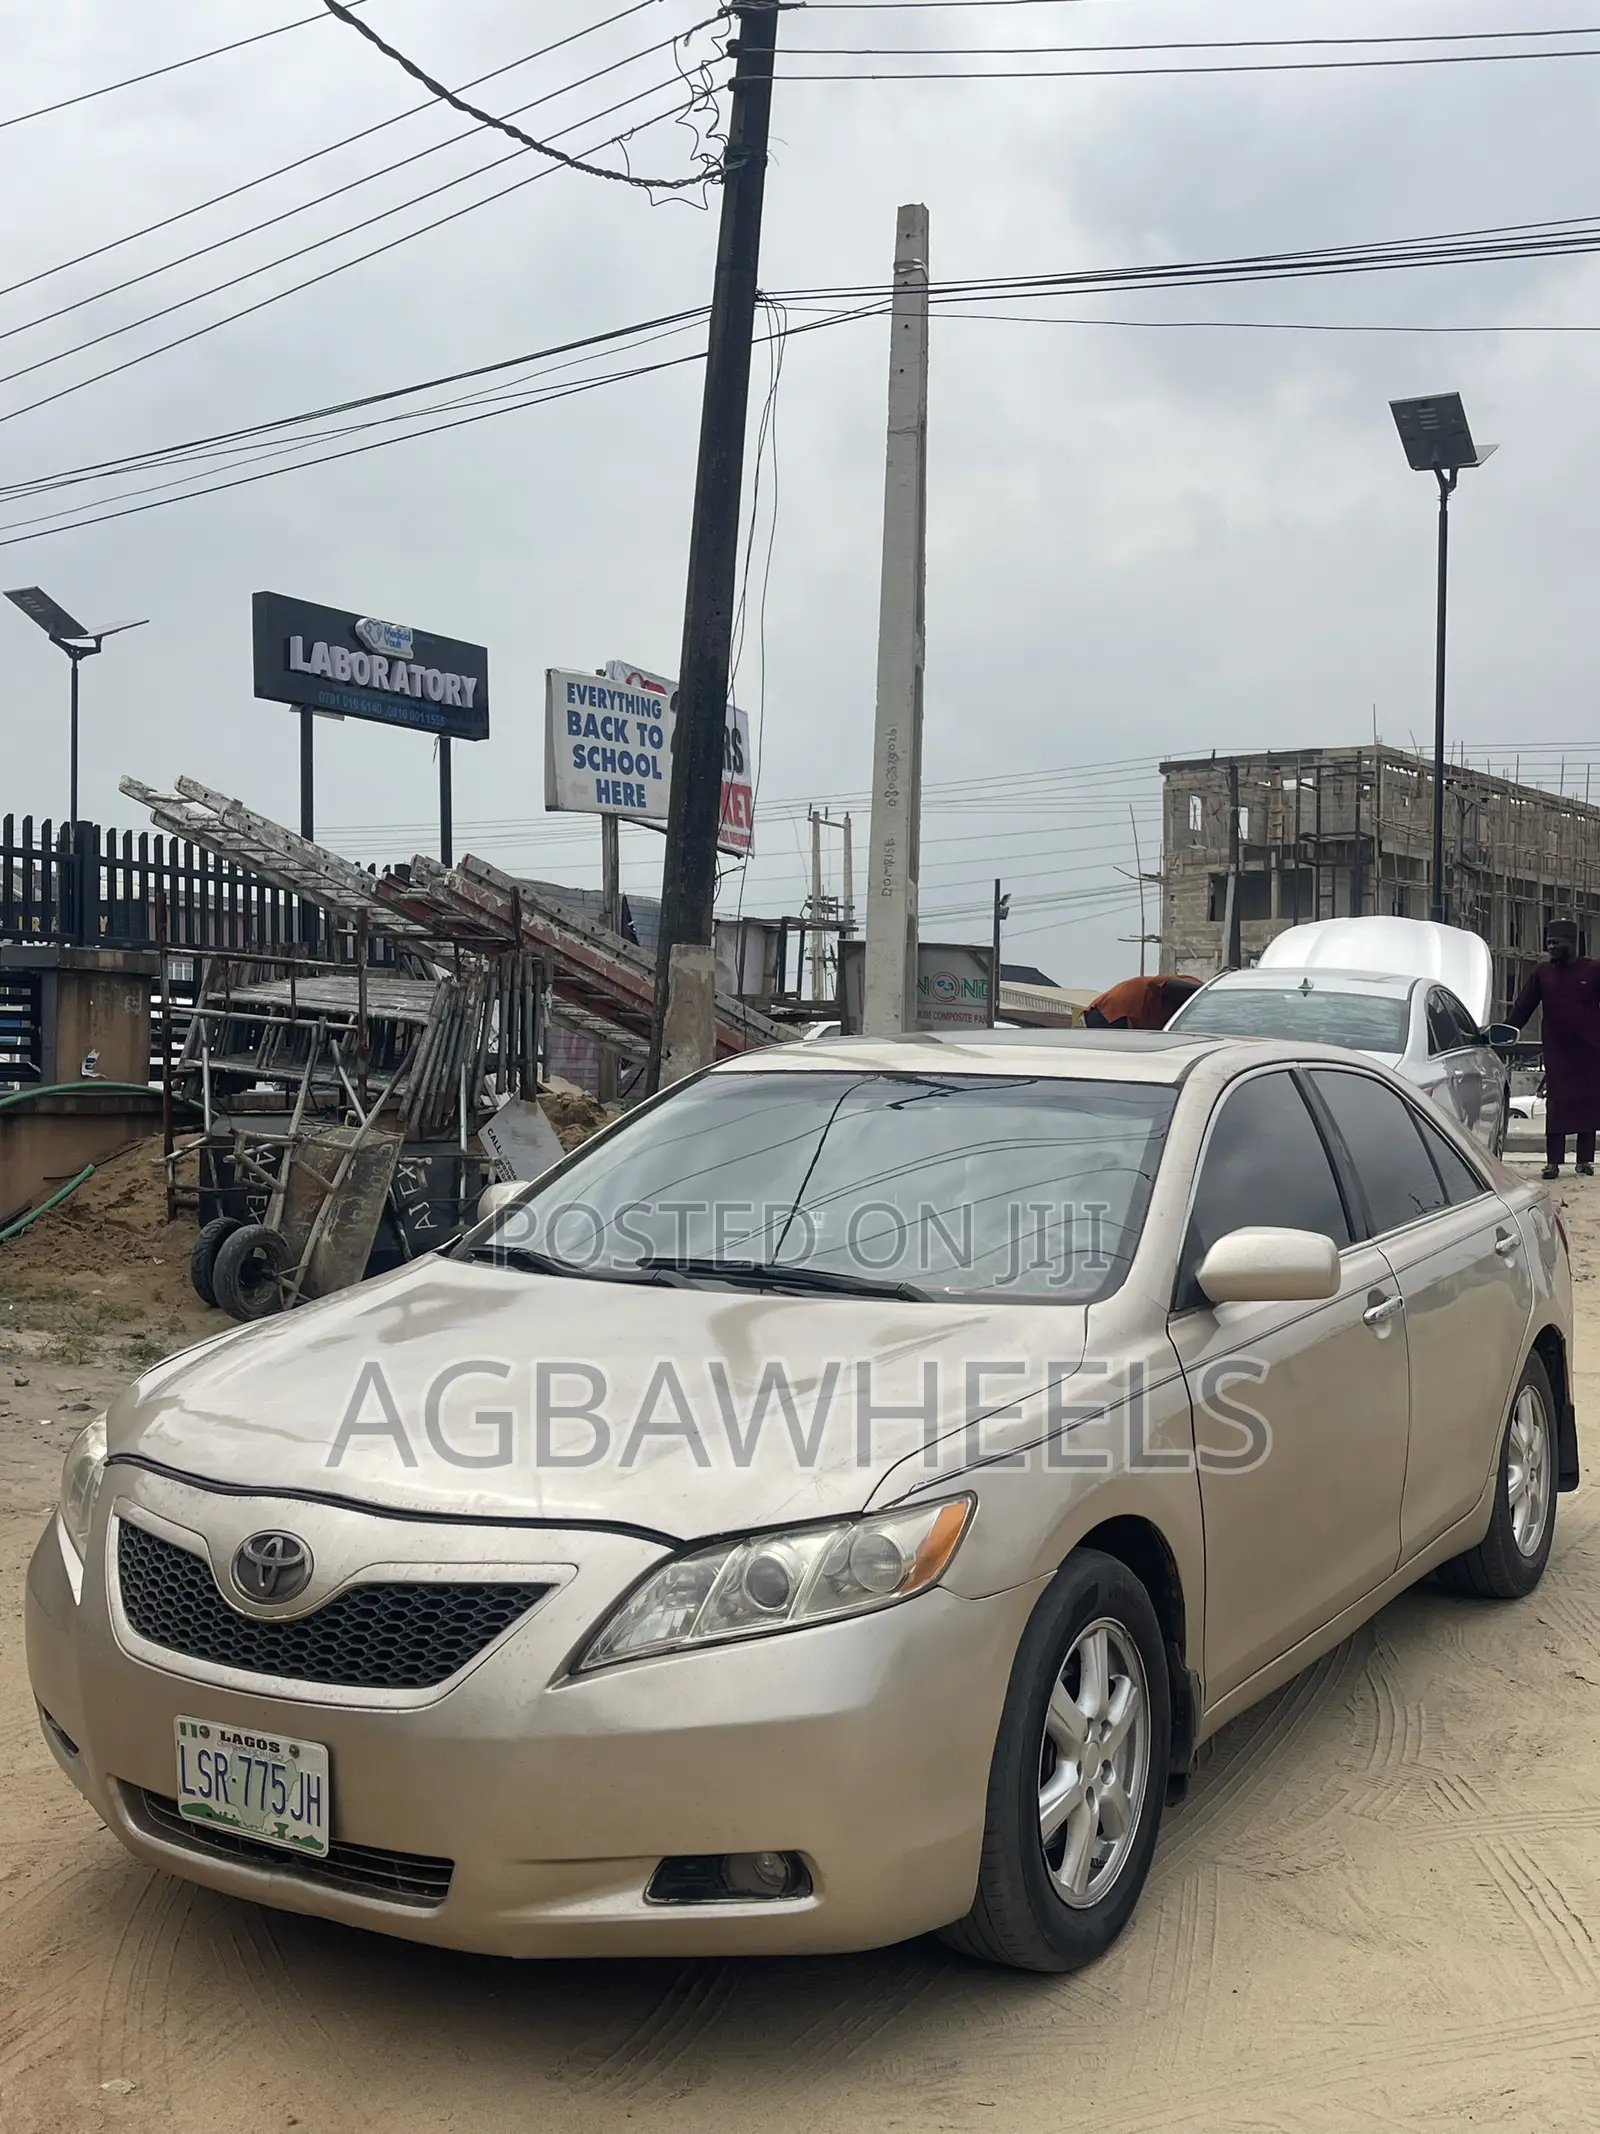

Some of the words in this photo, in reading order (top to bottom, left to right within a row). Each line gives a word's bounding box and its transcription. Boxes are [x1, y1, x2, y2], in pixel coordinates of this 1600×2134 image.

[384, 626, 412, 643] Medical
[289, 635, 478, 708] LABORATORY
[566, 682, 663, 720] EVERYTHING
[566, 709, 630, 744] BACK
[636, 721, 664, 750] TO
[572, 743, 663, 780] SCHOOL
[595, 778, 647, 809] HERE
[933, 1011, 972, 1023] COMPOSITE
[219, 1730, 280, 1753] LAGOS
